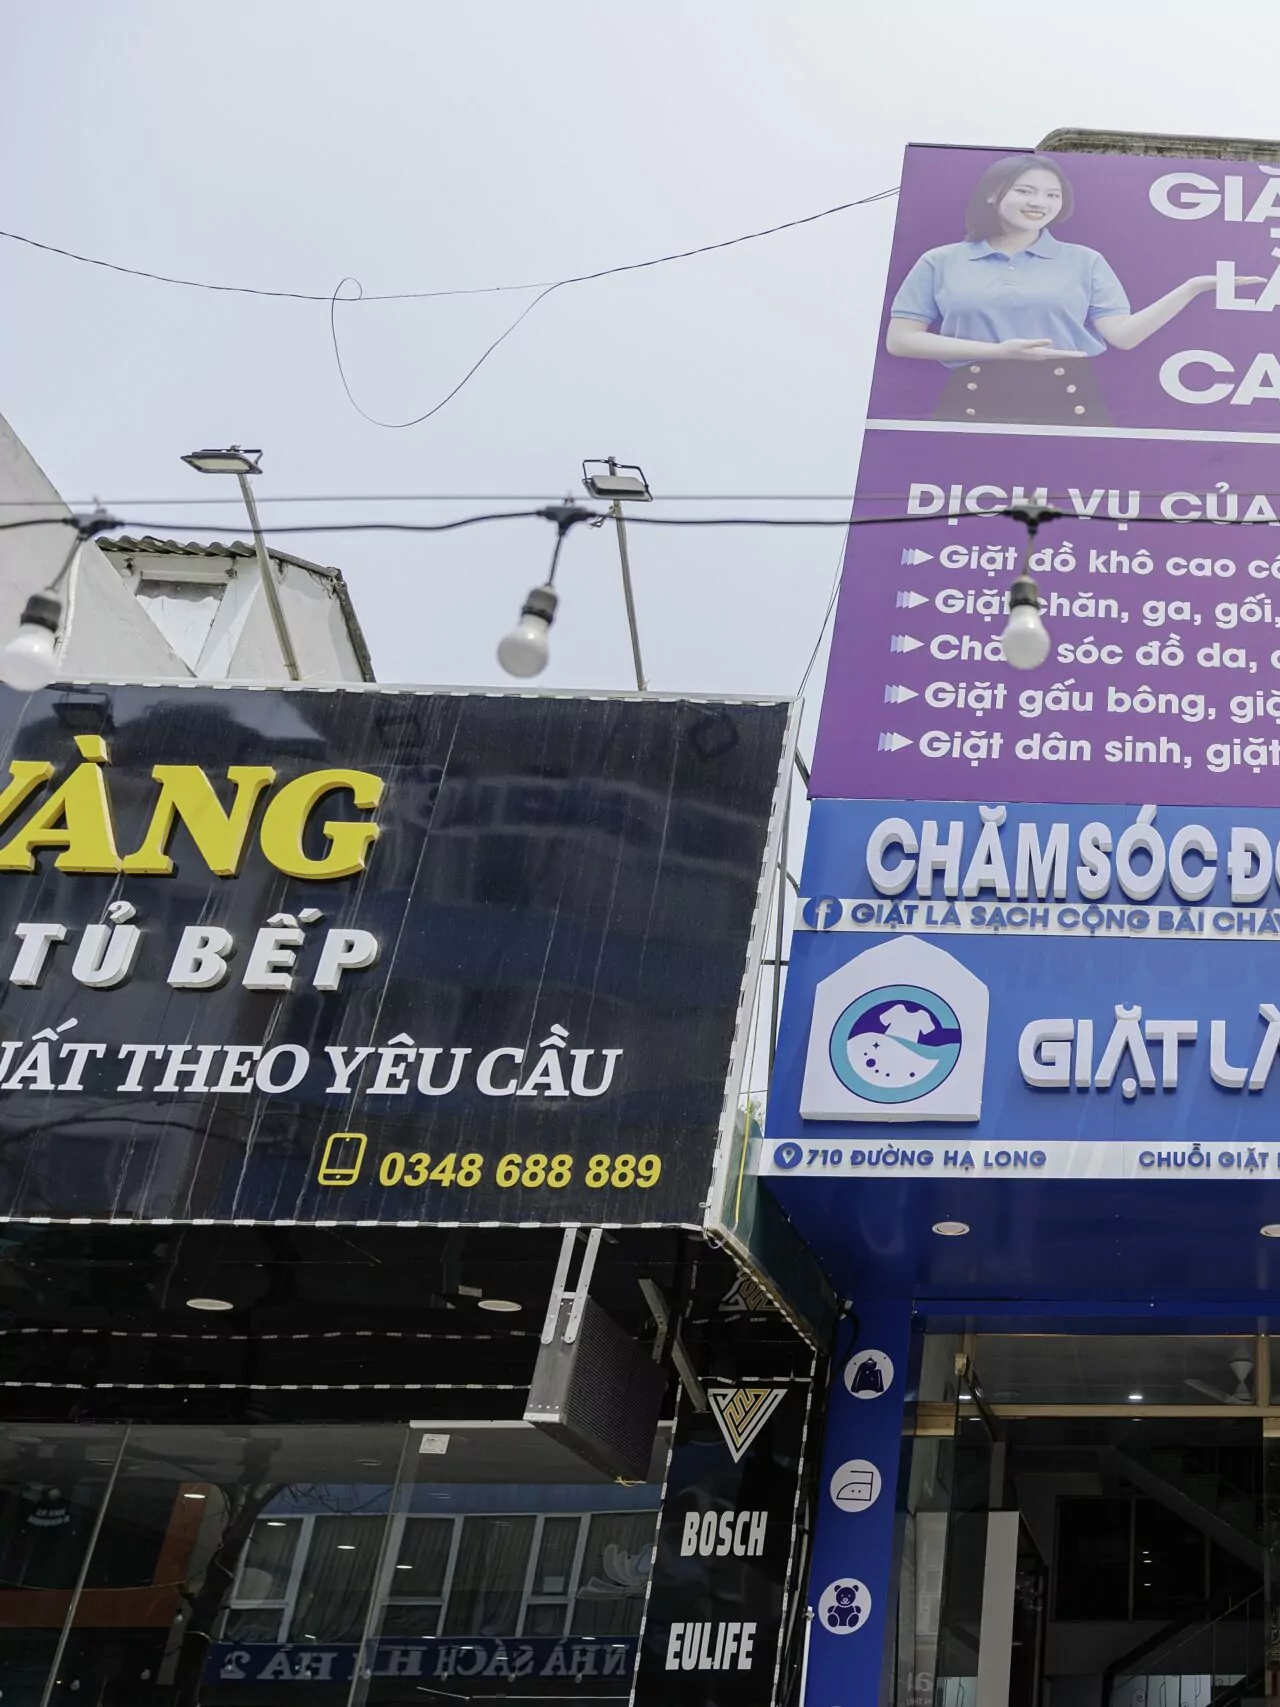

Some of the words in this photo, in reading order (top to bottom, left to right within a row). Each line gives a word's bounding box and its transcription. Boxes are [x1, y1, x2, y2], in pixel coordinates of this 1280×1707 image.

[1067, 488, 1140, 530] VỤ
[939, 545, 1018, 577] Giặt
[1028, 541, 1076, 573] đồ
[1089, 549, 1154, 575] khô
[1165, 556, 1236, 578] cao
[935, 588, 1010, 622] Giặt
[1142, 599, 1202, 627] ga,
[929, 634, 1007, 662] Chă
[1057, 635, 1123, 665] sóc
[1135, 632, 1184, 667] đồ
[1197, 642, 1257, 674] da,
[924, 680, 1006, 715] Giặt
[1018, 679, 1093, 718] gấu
[1107, 683, 1216, 722] bông,
[919, 731, 1003, 766] Giặt
[1015, 731, 1091, 763] dân
[1103, 734, 1192, 770] sinh,
[866, 805, 1069, 899] CHĂM
[1076, 804, 1218, 901] SÓC
[970, 905, 1049, 932] SẠCH
[1057, 903, 1150, 937] CỘNG
[1158, 906, 1204, 933] BÃI
[10, 900, 143, 989] TỦ
[167, 907, 379, 991] BẾP
[116, 1042, 310, 1094] THEO
[324, 1032, 472, 1096] YÊU
[475, 1023, 623, 1098] CẦU
[1018, 1003, 1198, 1099] GIẶT
[378, 1151, 483, 1187] 0348
[494, 1152, 574, 1188] 688
[584, 1153, 662, 1188] 889
[806, 1149, 843, 1168] 710
[850, 1143, 934, 1168] ĐƯỜNG
[943, 1150, 975, 1171] HẠ
[983, 1150, 1047, 1169] LONG
[1218, 1148, 1269, 1173] GIẶT
[680, 1510, 768, 1557] BOSCH
[665, 1621, 757, 1671] EULIFE
